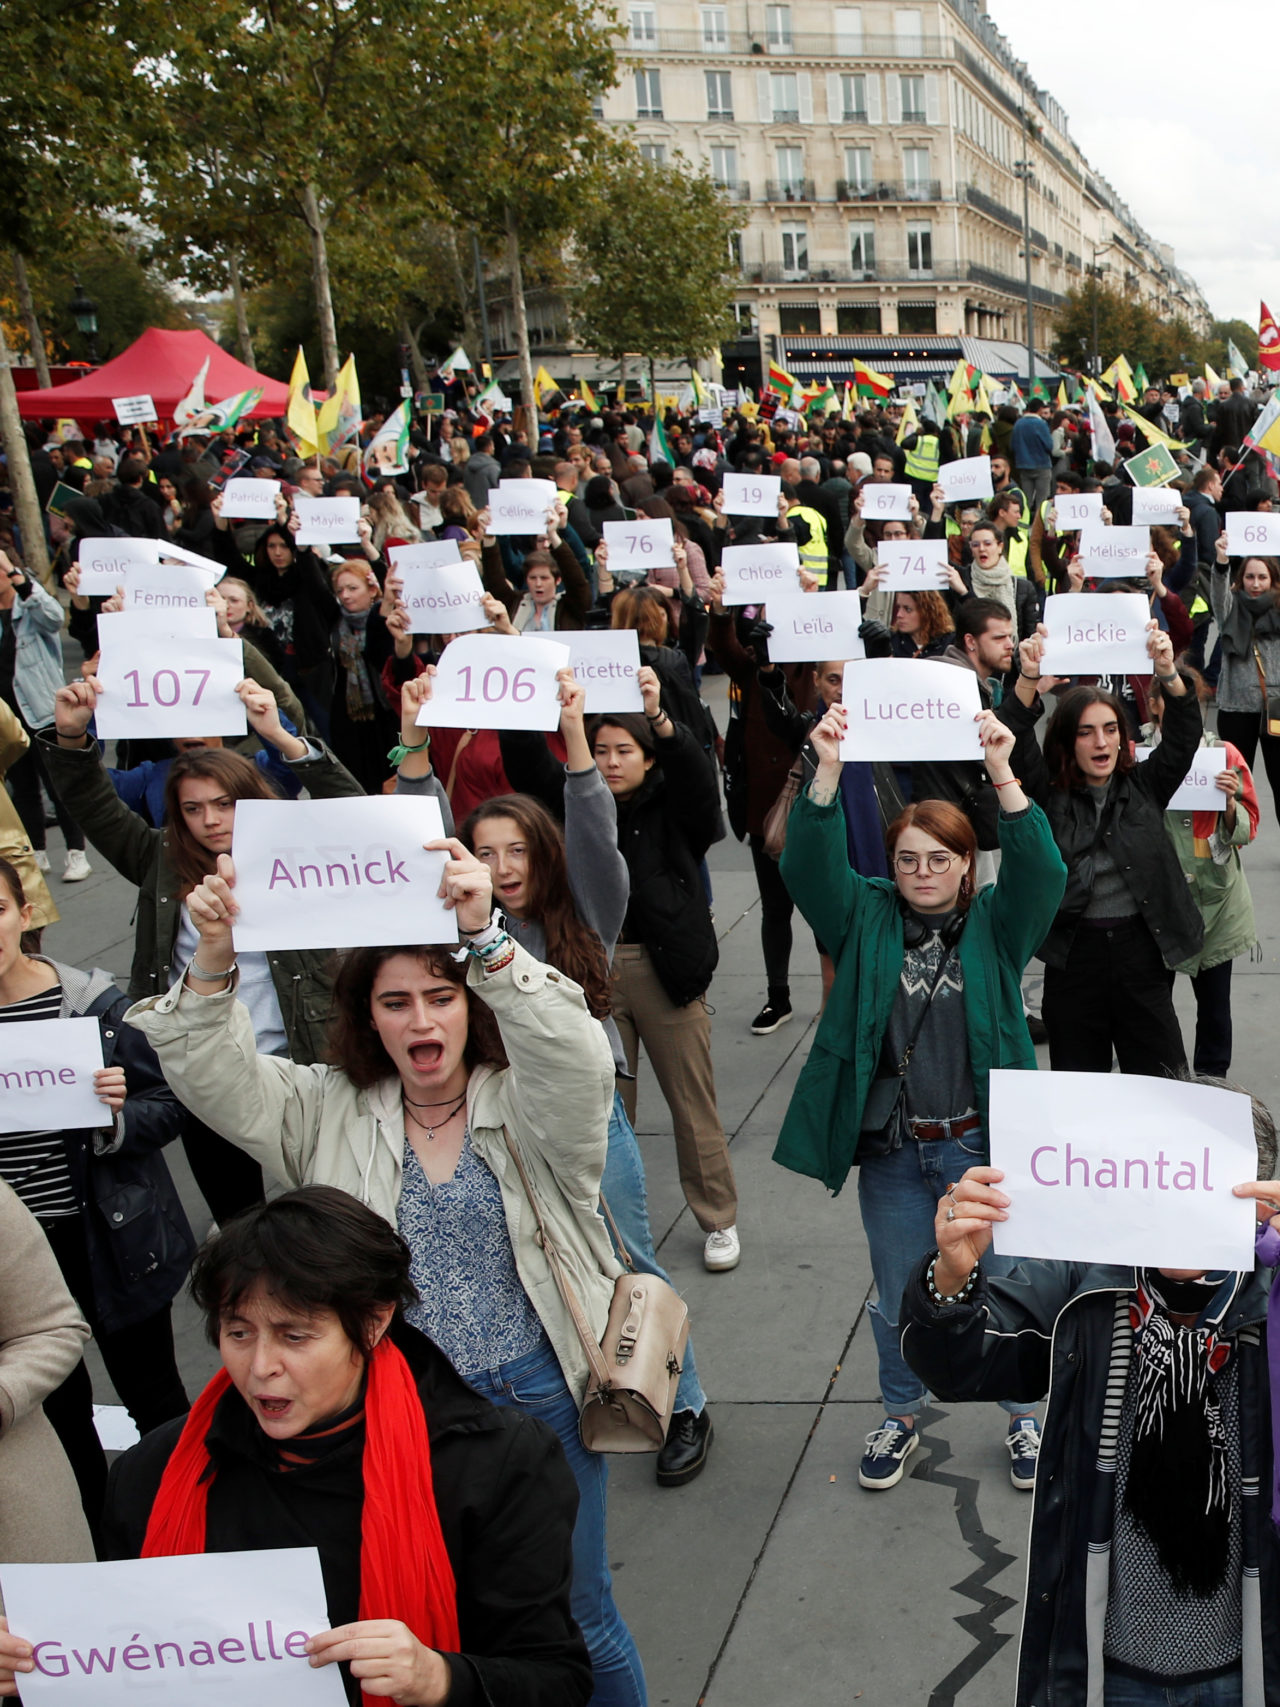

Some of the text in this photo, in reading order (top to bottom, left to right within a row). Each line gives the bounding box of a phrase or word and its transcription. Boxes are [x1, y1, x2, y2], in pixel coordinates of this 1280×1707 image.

[949, 474, 977, 487] Daisy
[231, 490, 269, 504] Patricia
[742, 488, 763, 503] 19
[877, 495, 896, 509] 67
[499, 505, 535, 518] Céline
[1070, 505, 1088, 518] 10
[1244, 526, 1267, 542] 68
[625, 535, 653, 553] 76
[1090, 544, 1138, 559] Mélissa
[739, 565, 782, 580] Chloé
[900, 556, 926, 575] 74
[134, 590, 198, 608] Femme
[793, 617, 833, 635] Leïla
[1067, 623, 1126, 645] Jackie
[572, 662, 634, 679] ricette
[123, 670, 210, 708] 107
[456, 666, 536, 703] 106
[863, 697, 961, 721] Lucette
[1184, 771, 1207, 786] ela
[268, 849, 411, 890] Annick
[0, 1067, 76, 1089] mme
[1030, 1142, 1214, 1192] Chantal
[34, 1620, 312, 1678] Gwénaelle
